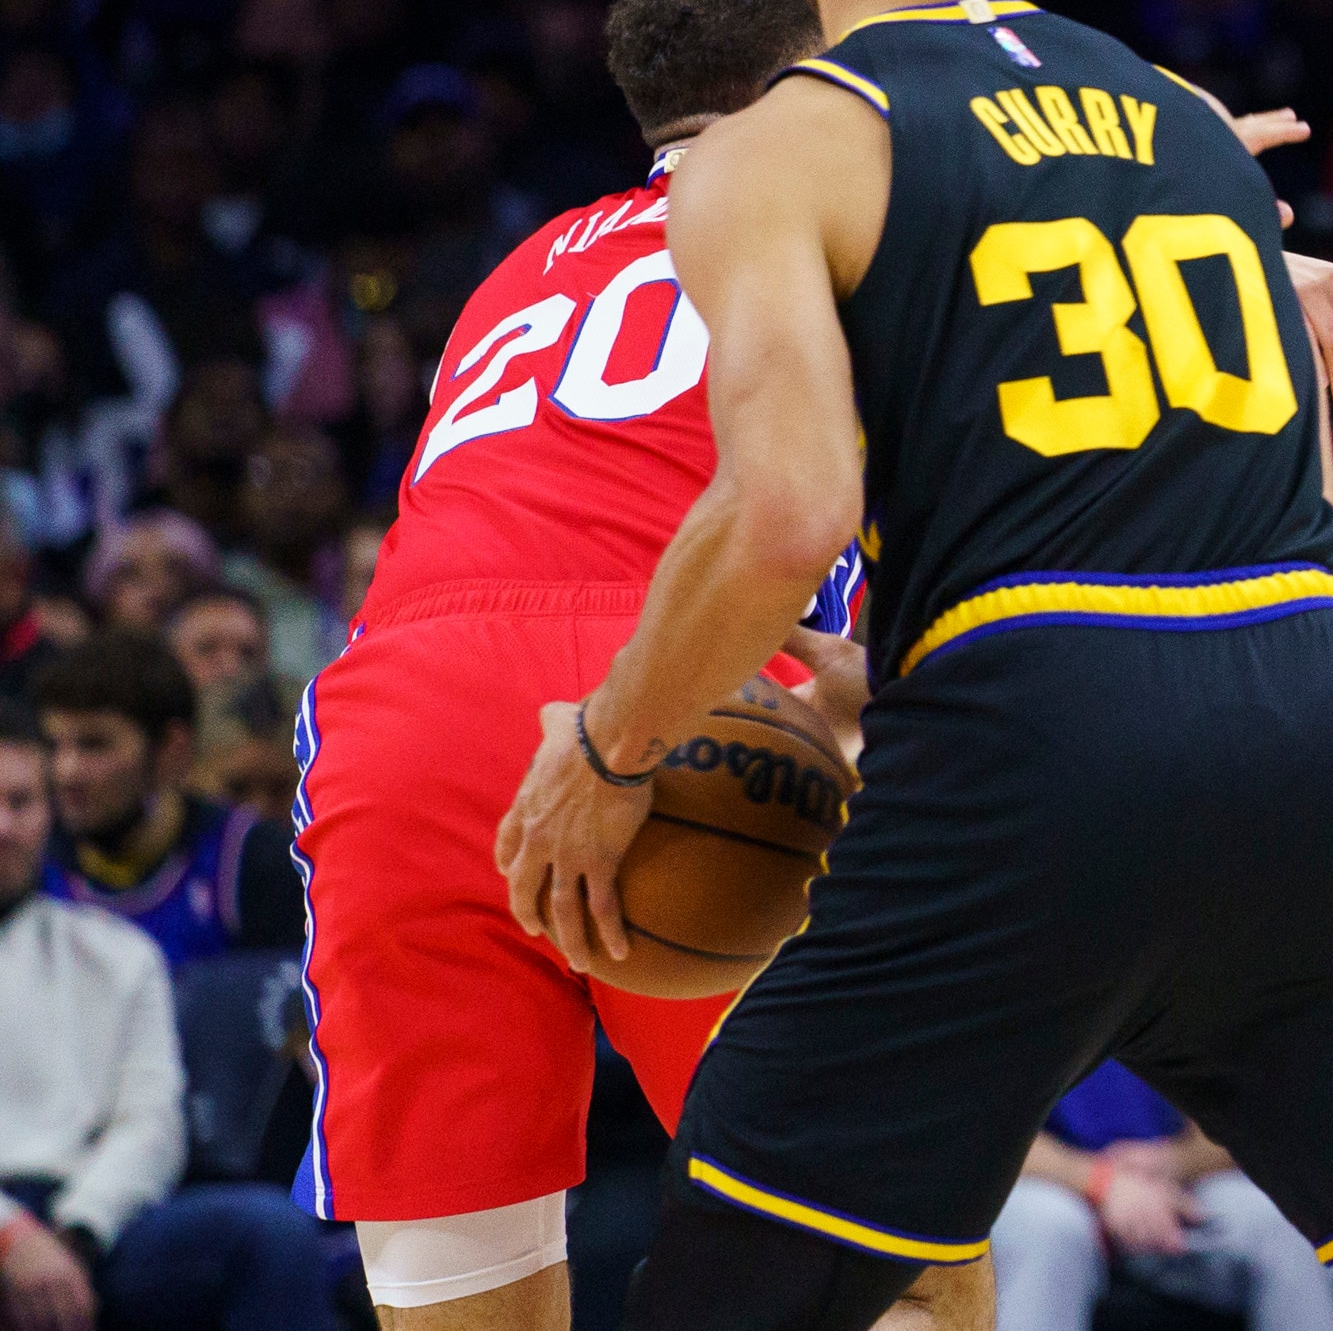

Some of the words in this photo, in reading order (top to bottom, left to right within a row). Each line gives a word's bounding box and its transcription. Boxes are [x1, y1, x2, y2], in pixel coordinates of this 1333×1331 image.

[969, 85, 1157, 166] CURRY
[410, 248, 711, 489] 20
[969, 214, 1299, 458] 30
